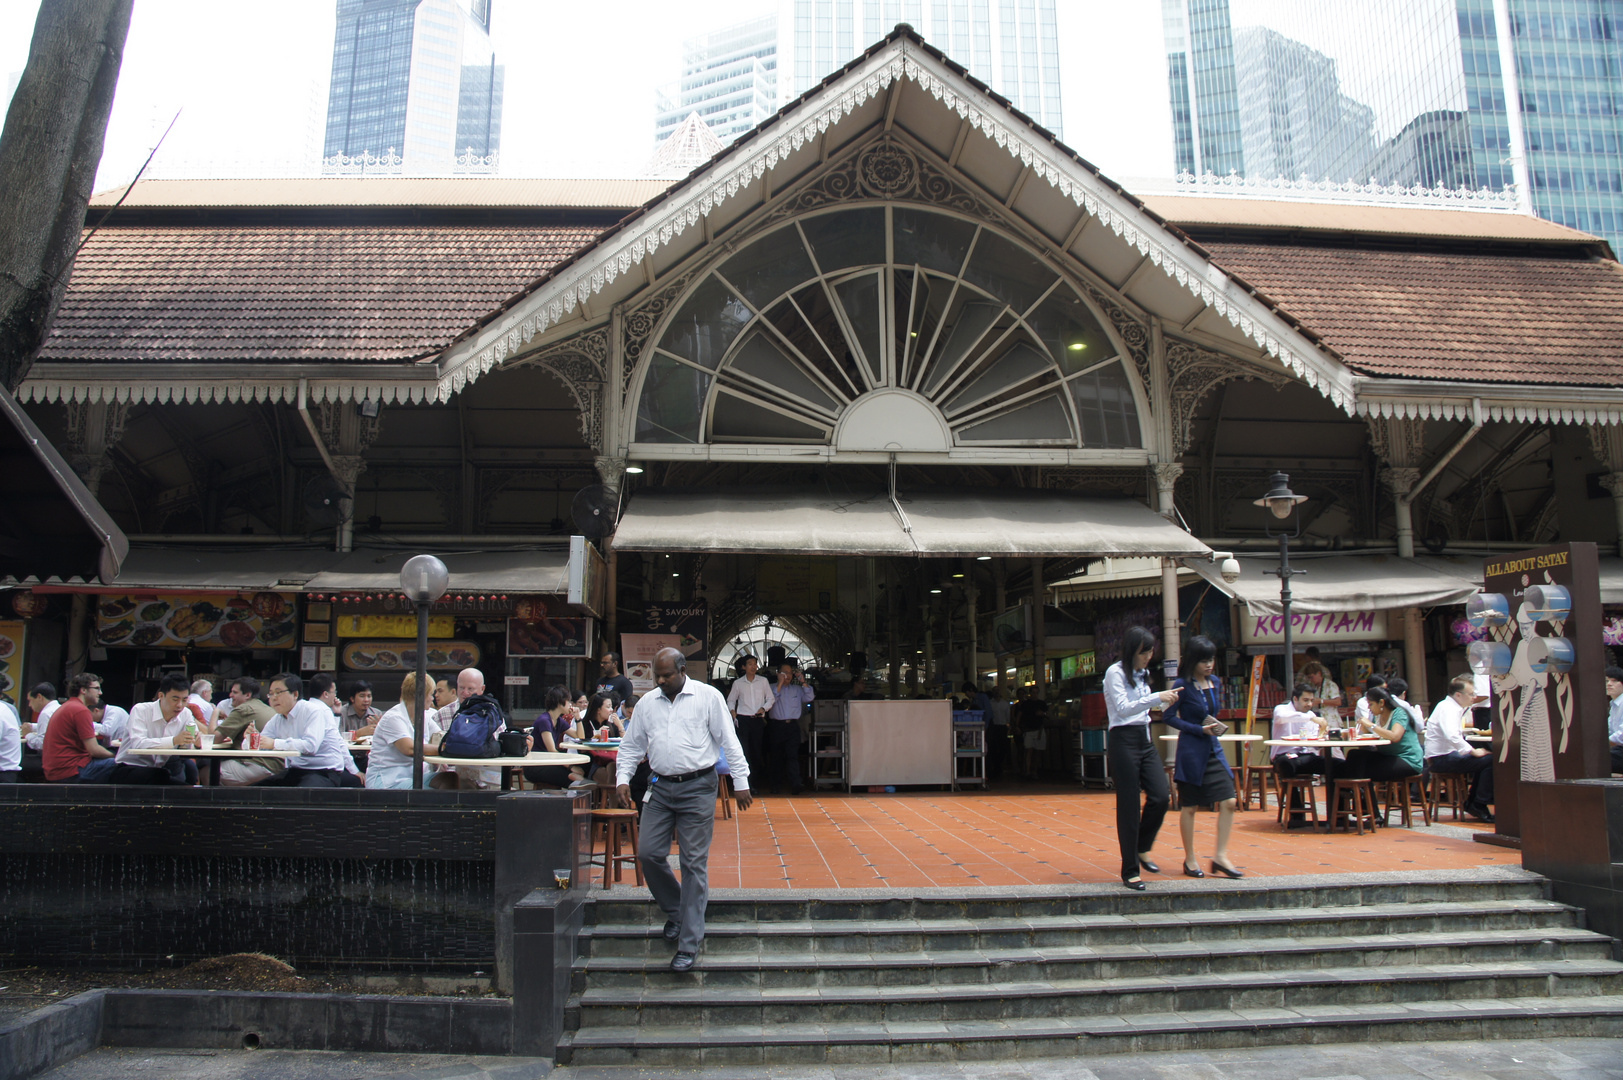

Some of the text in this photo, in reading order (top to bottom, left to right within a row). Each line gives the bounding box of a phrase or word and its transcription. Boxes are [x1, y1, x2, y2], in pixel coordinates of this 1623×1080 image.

[1486, 551, 1569, 577] ALL ABOUT SATAY
[645, 605, 664, 630] 享
[665, 608, 706, 616] SAVOURY
[1253, 611, 1376, 637] KOPITIAM
